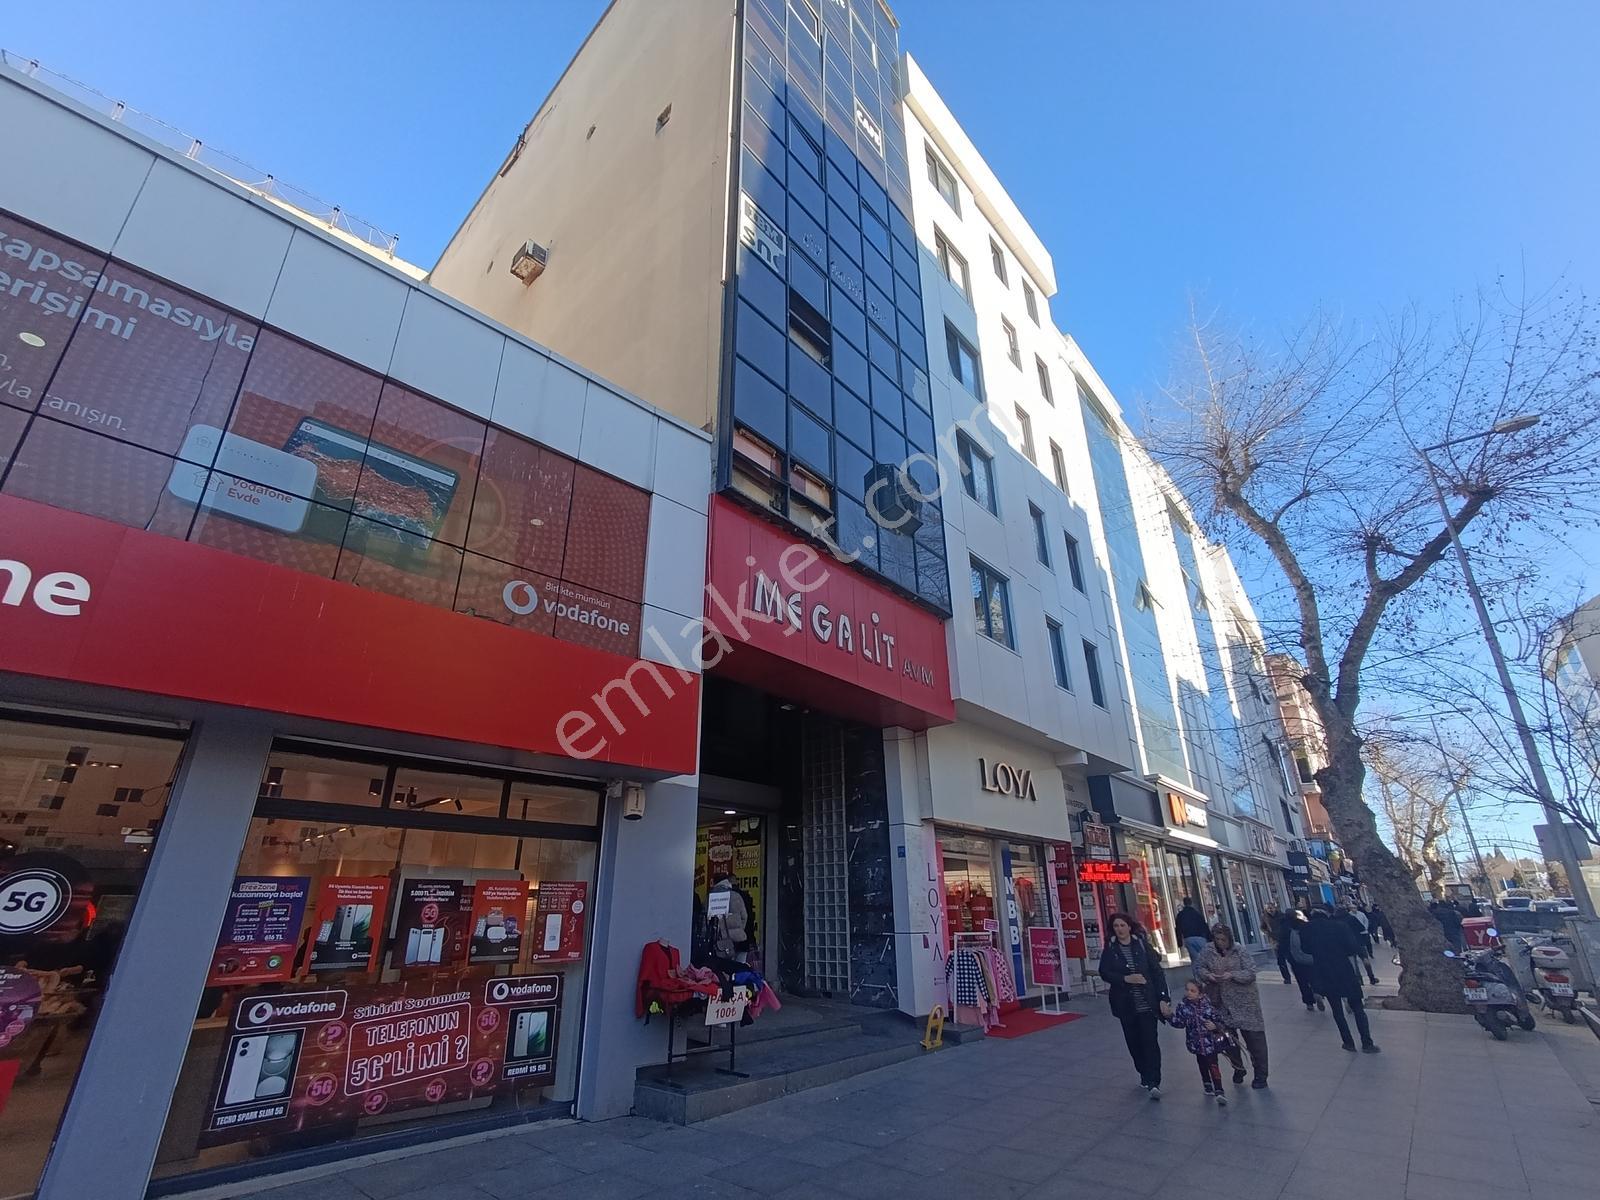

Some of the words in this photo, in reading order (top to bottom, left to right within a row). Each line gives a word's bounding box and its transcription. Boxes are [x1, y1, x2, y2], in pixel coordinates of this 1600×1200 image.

[0, 231, 256, 352] apsamasıyla
[227, 488, 260, 505] Evde
[545, 581, 574, 598] Birlkte
[543, 598, 630, 636] vodafone
[2, 891, 48, 913] 5G
[510, 982, 552, 995] vodafone
[710, 991, 744, 1005] PAÇA
[276, 1001, 336, 1016] vodafone
[353, 998, 403, 1019] Sihirli
[480, 1011, 498, 1026] 5G
[366, 1010, 460, 1047] TELEFONUN
[311, 1079, 333, 1097] 5G
